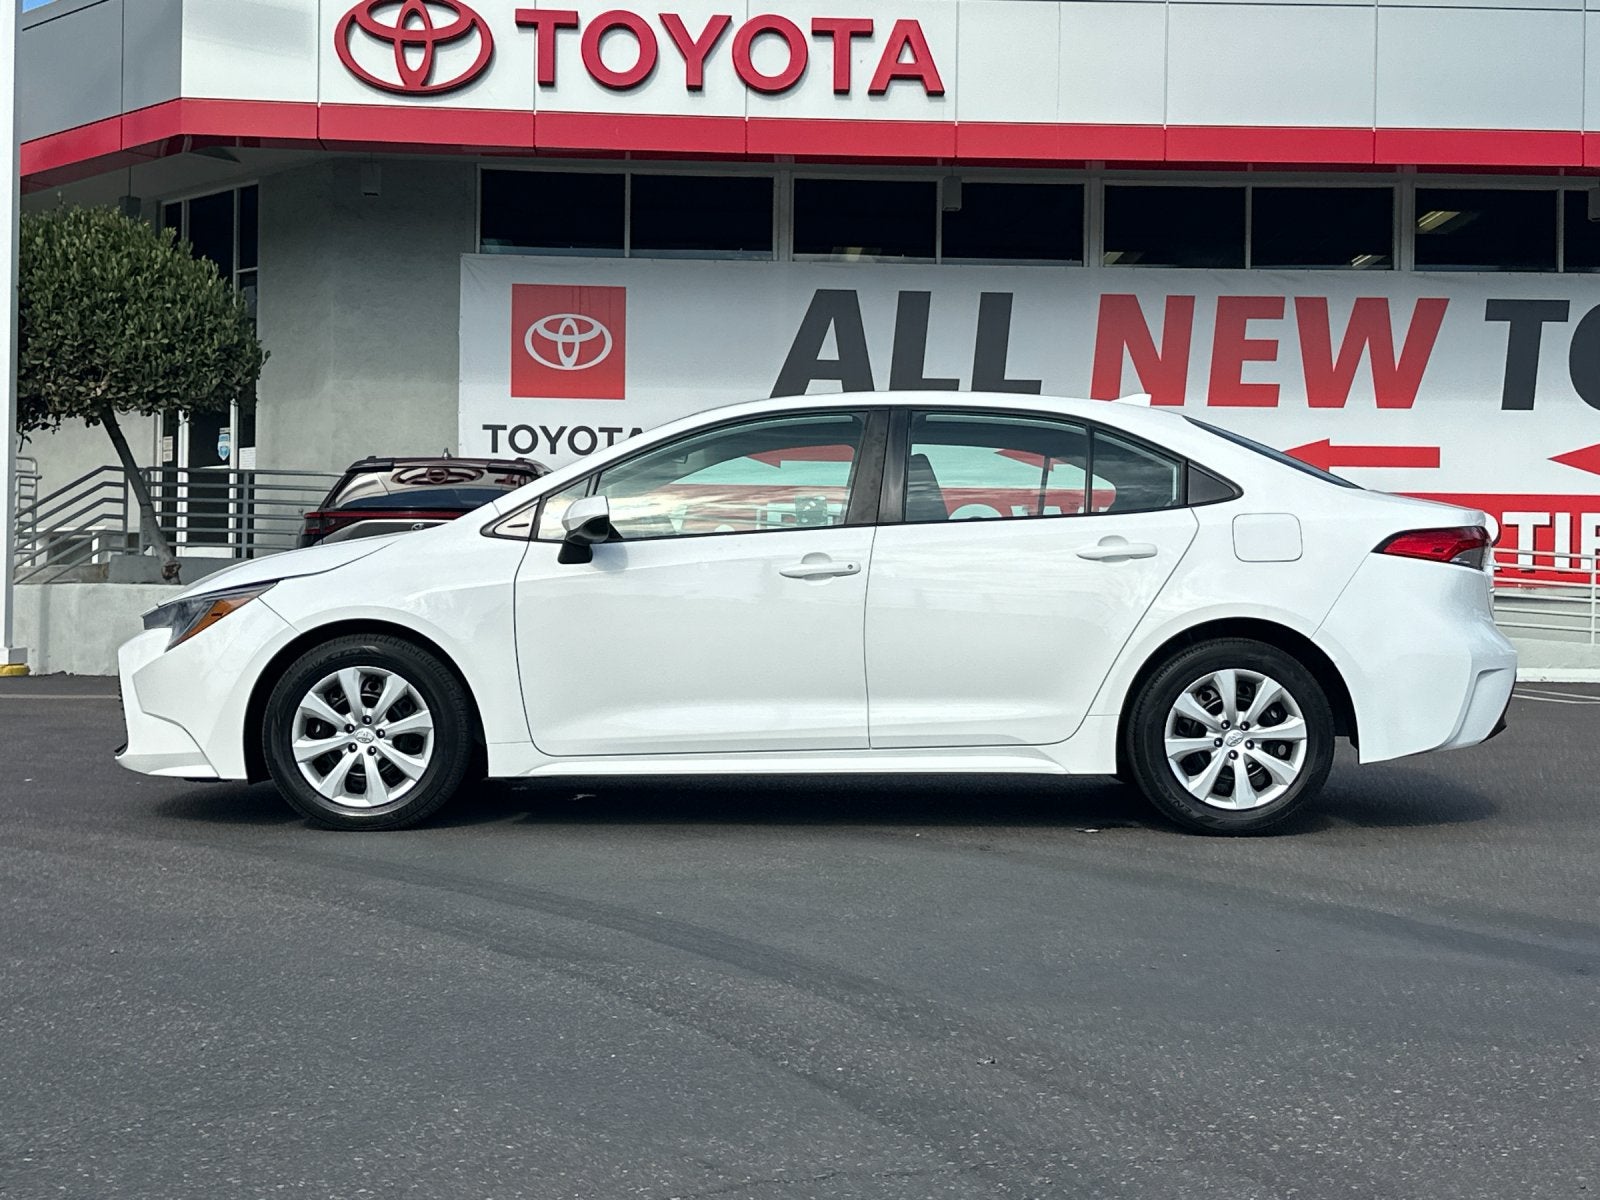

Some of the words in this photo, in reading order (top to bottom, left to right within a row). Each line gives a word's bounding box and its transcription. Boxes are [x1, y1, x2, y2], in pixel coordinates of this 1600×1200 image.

[515, 8, 945, 96] TOYOTA
[769, 288, 1042, 399] ALL
[1090, 294, 1450, 409] NEW
